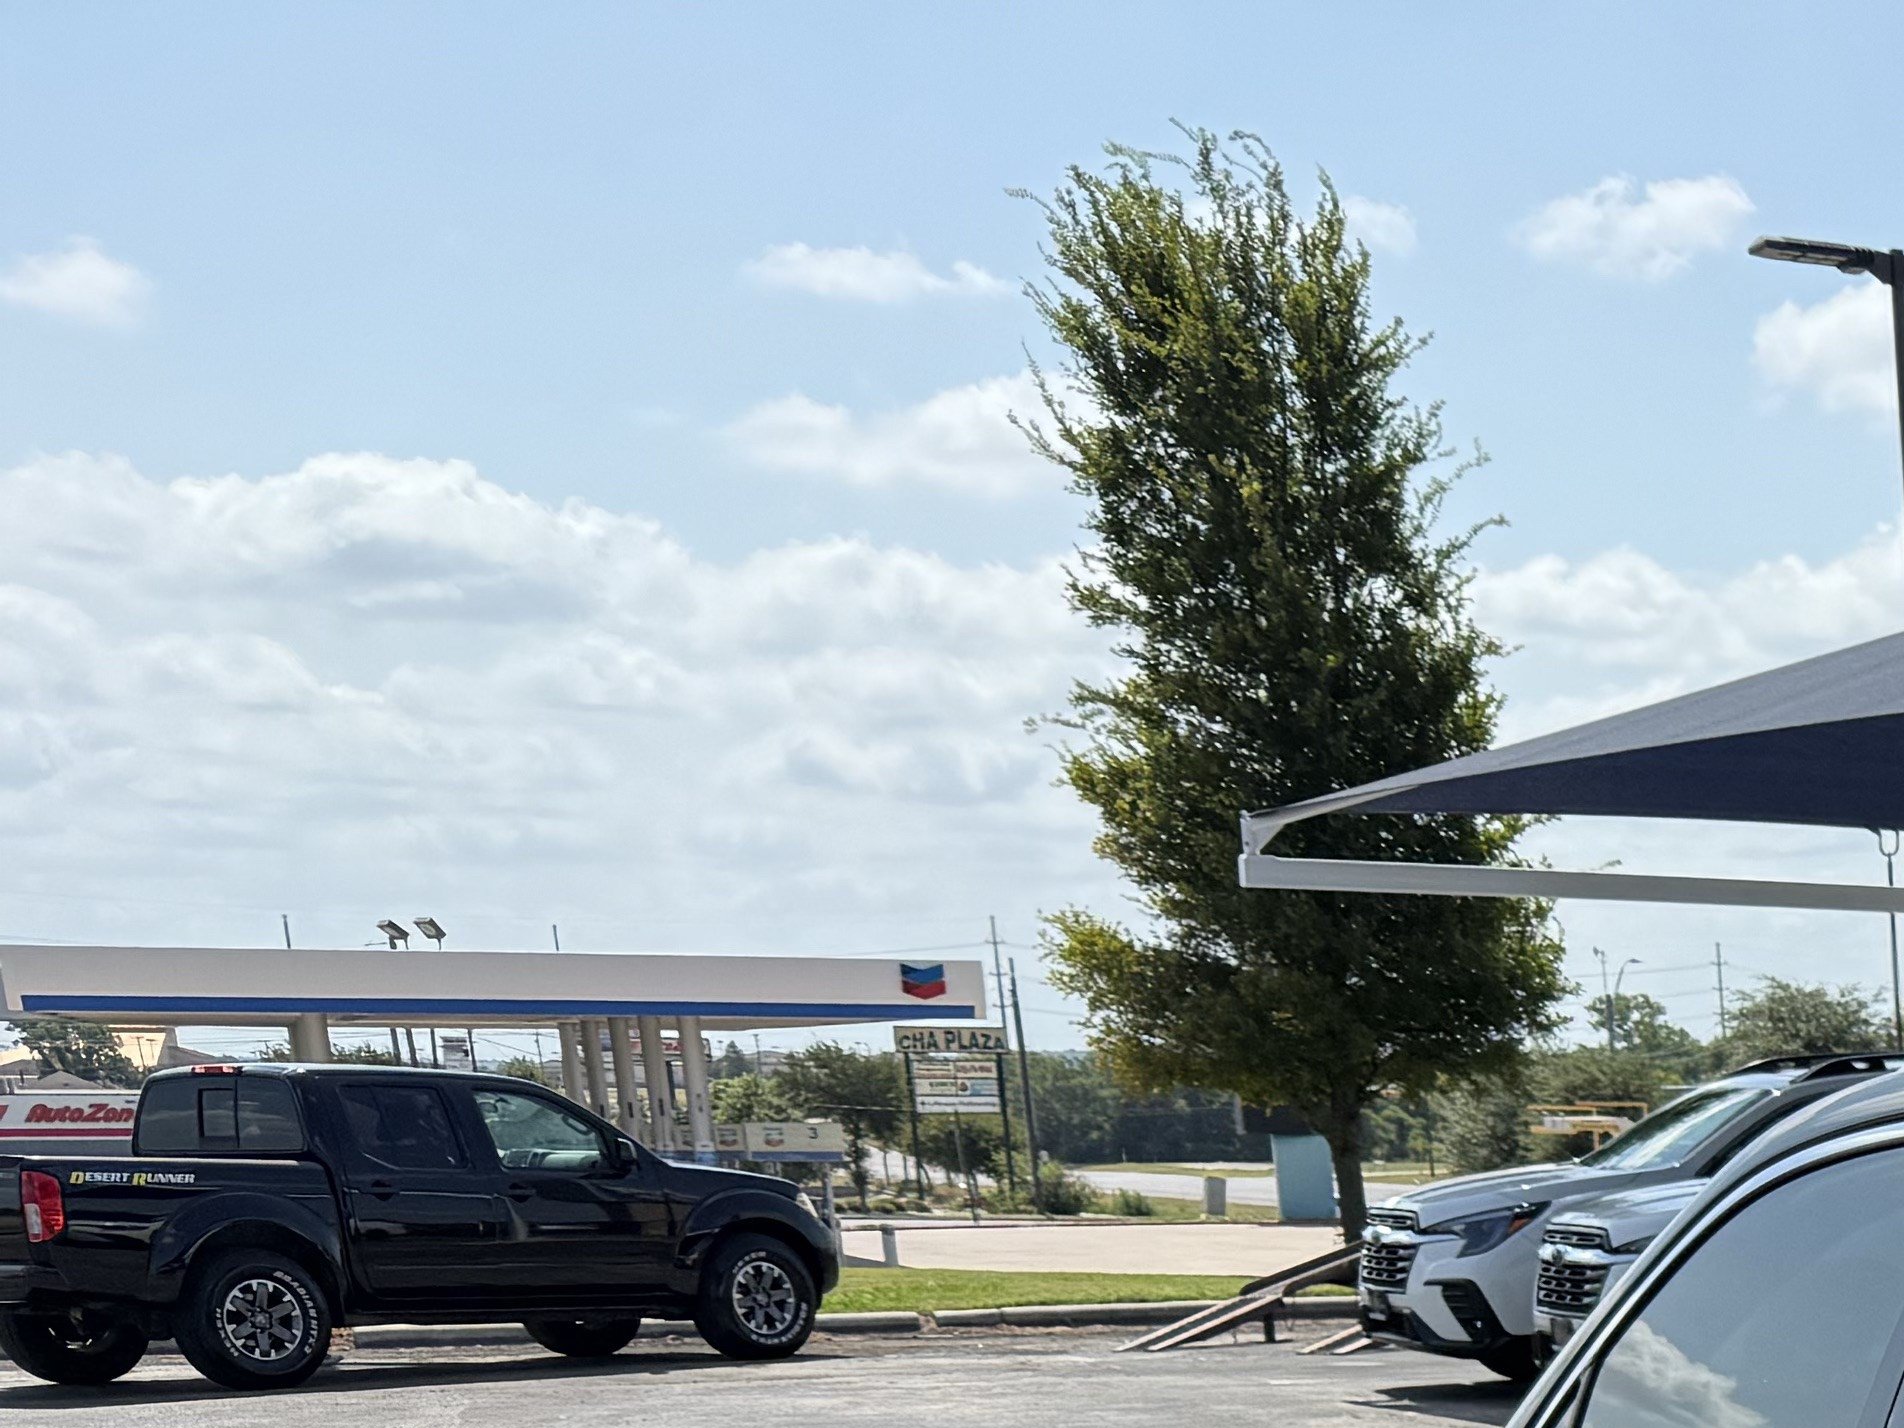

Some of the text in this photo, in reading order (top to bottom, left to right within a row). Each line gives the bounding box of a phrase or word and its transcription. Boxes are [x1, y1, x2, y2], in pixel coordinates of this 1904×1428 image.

[900, 1030, 1005, 1050] CHA PLAZA
[25, 1103, 135, 1123] AutoZon
[807, 1127, 818, 1139] 3
[69, 1171, 195, 1186] DESERT RUNNER
